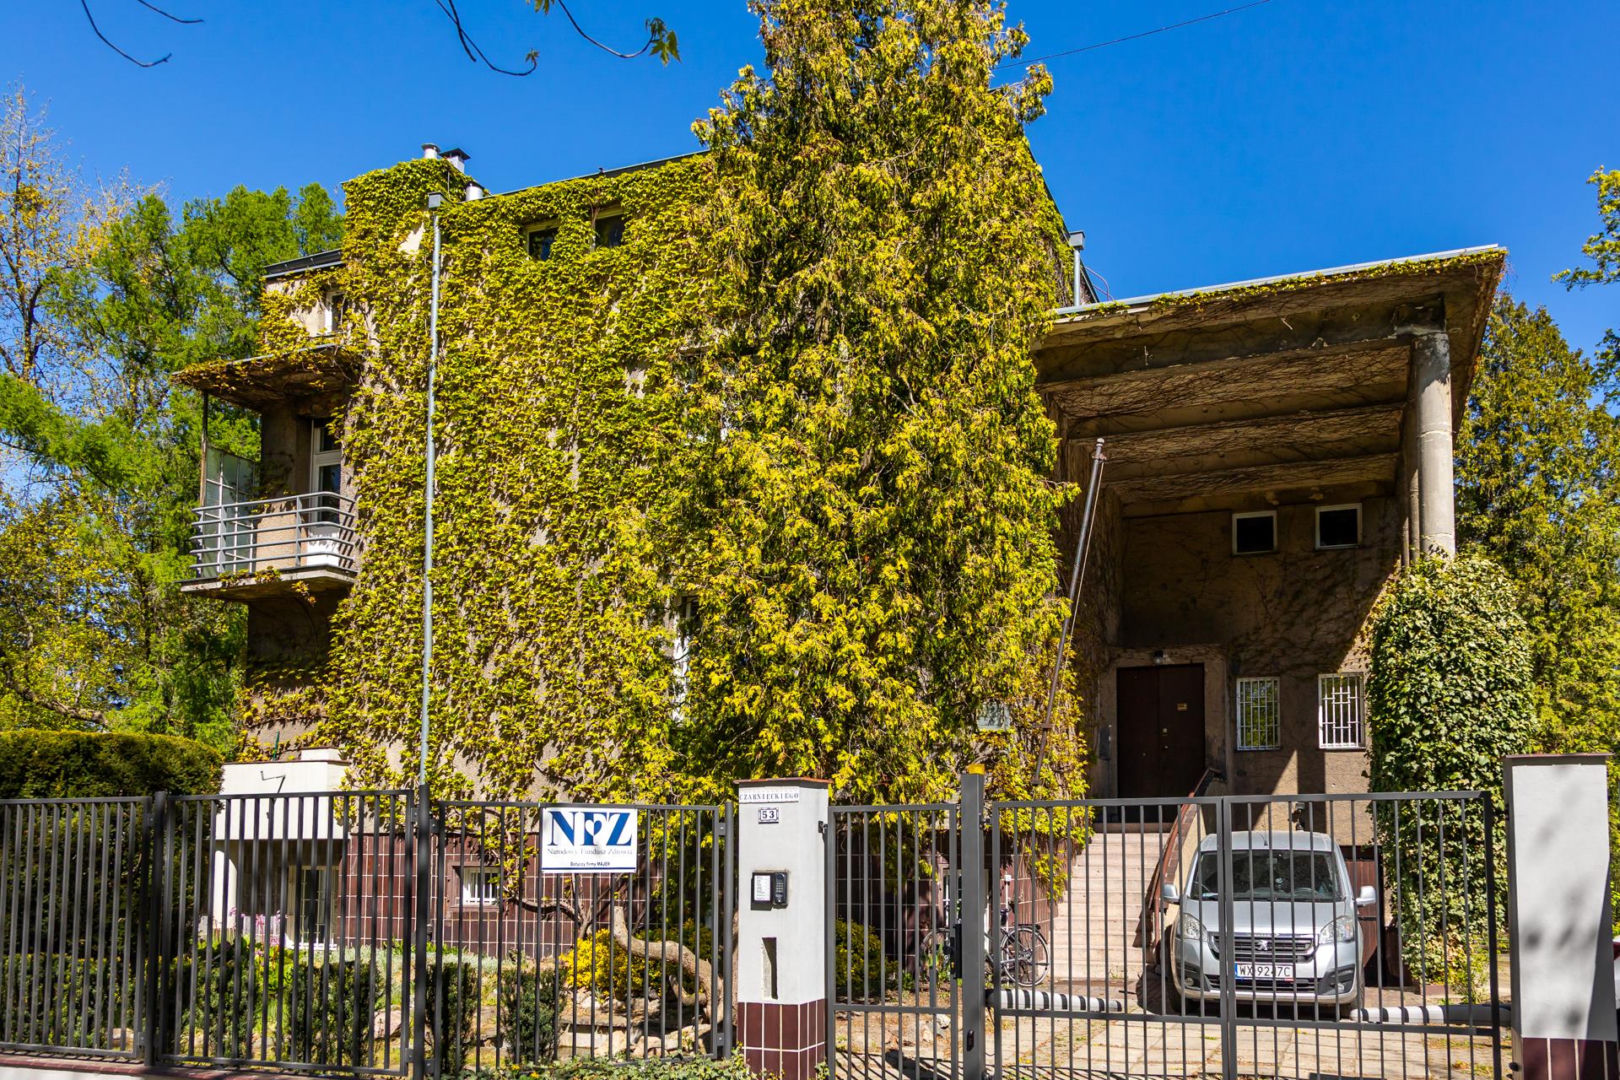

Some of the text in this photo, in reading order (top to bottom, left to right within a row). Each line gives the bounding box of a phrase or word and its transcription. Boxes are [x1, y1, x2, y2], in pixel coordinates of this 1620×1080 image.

[762, 810, 775, 819] 53
[547, 811, 632, 846] NFZ
[1257, 966, 1291, 977] 927C
